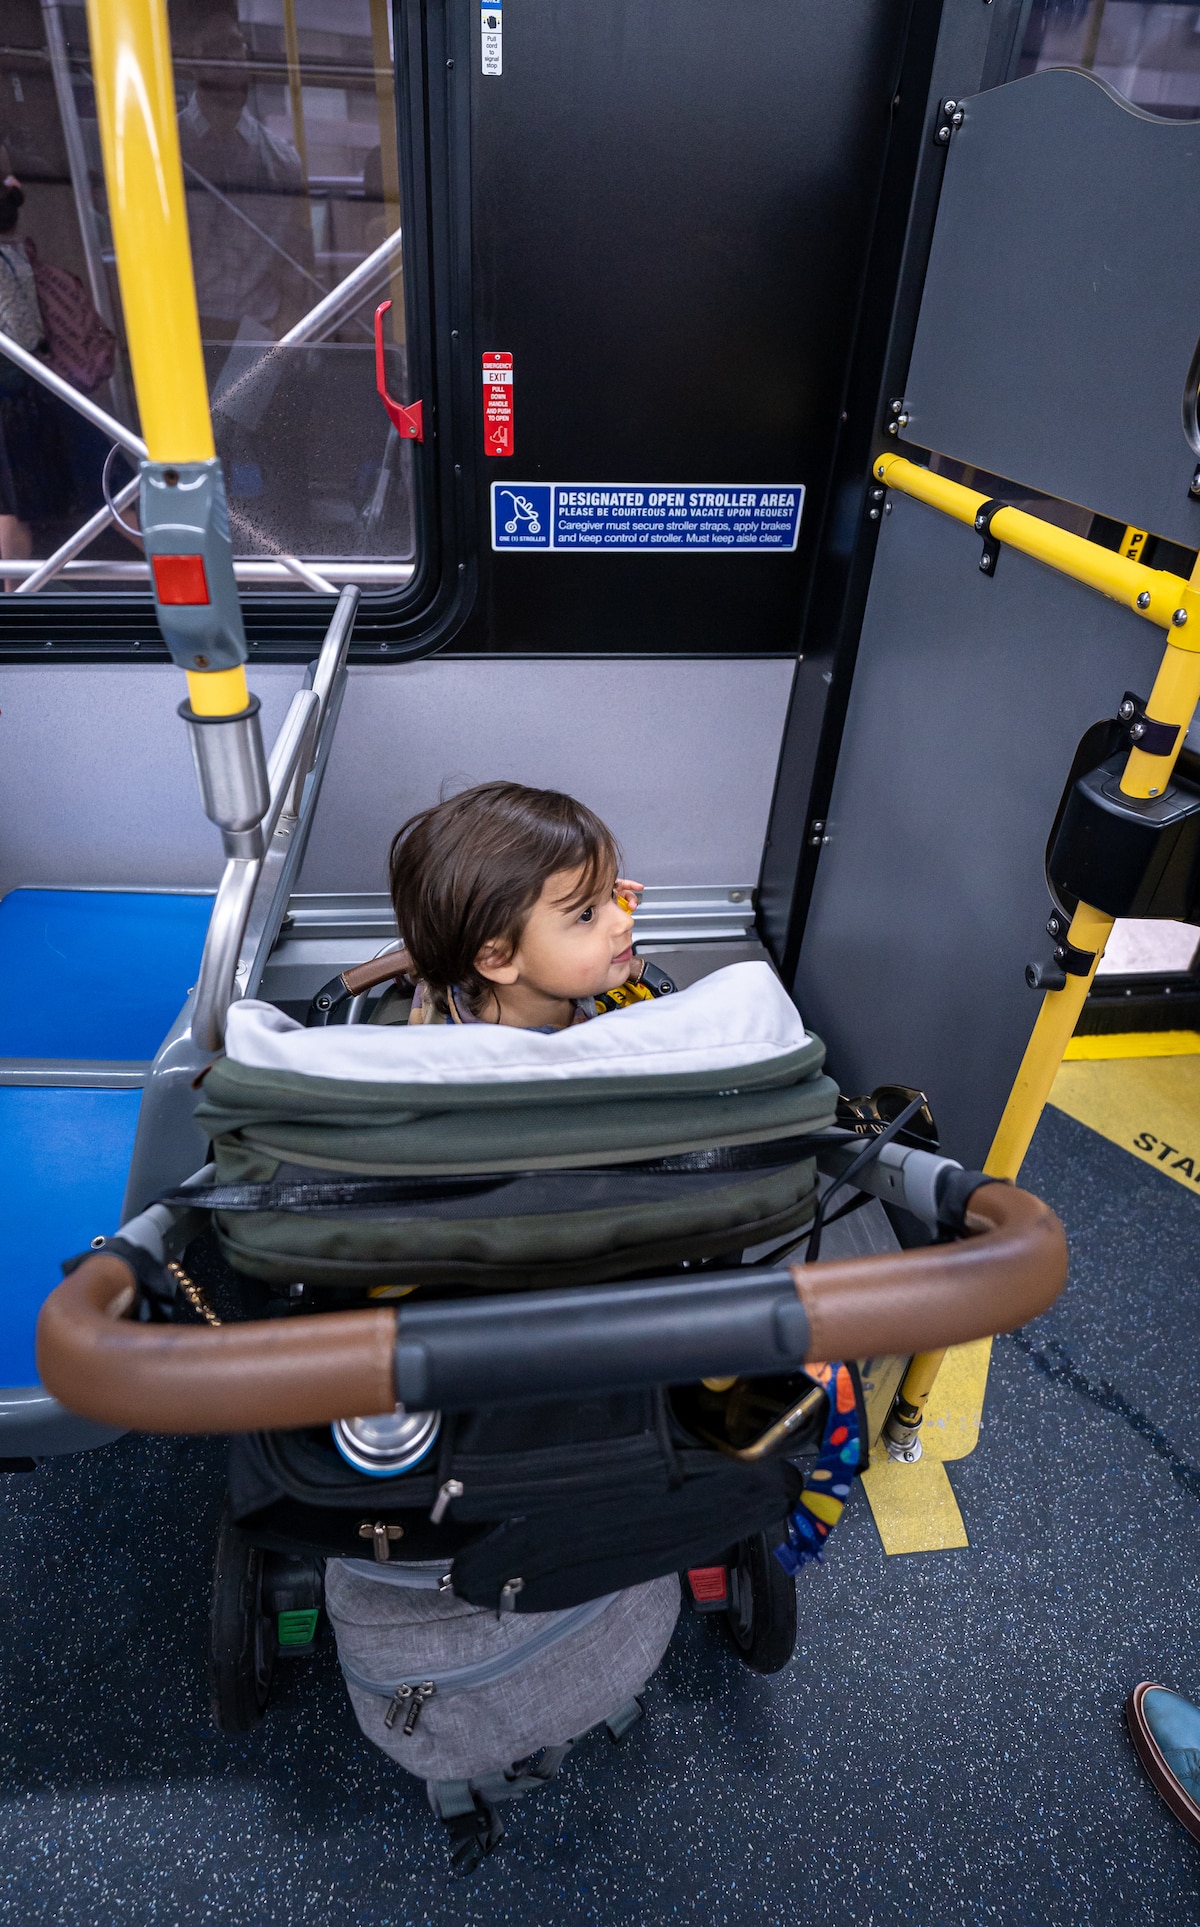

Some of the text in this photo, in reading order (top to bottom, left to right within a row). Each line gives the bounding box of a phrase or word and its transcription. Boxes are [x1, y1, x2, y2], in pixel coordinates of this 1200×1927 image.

[489, 373, 507, 382] EXIT
[558, 492, 796, 508] DESIGNATED OPEN STROLLER AREA
[558, 507, 795, 518] PLEASE BE COURTEOUS AND VACATE UPON REQUEST
[558, 519, 792, 533] Caregiver must secure stroller straps, apply brakes
[558, 533, 783, 545] and keep control of stroller. Must keep aisle clear.
